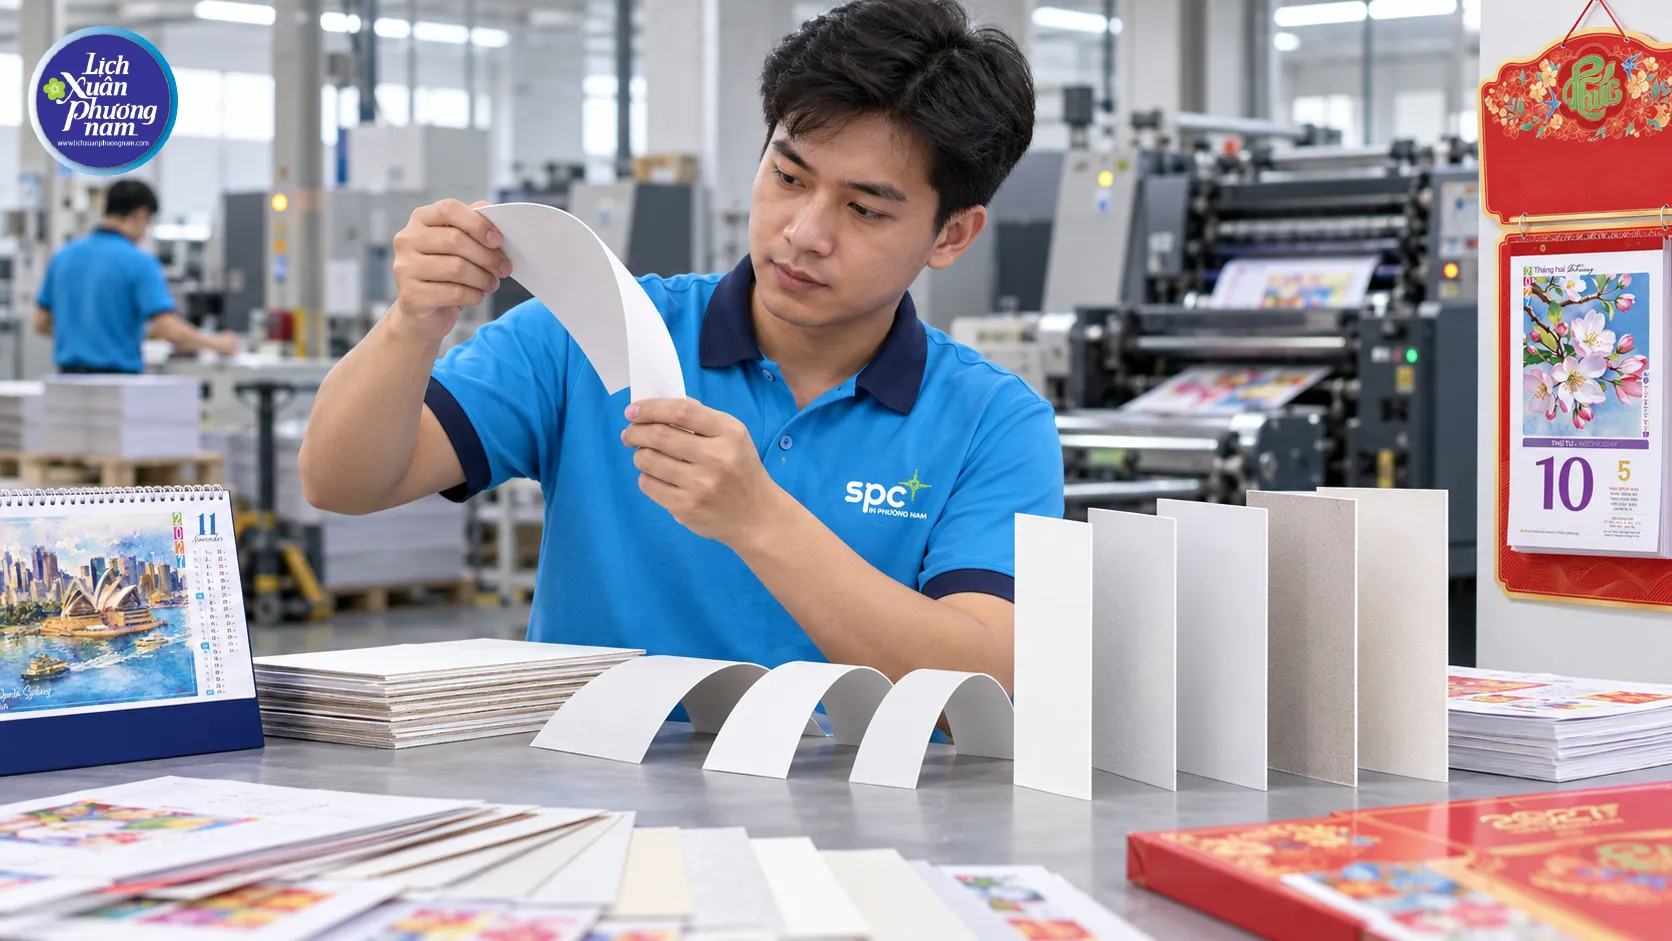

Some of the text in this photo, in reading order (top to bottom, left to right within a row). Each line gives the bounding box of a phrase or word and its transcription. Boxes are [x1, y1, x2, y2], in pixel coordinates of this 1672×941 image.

[844, 480, 907, 513] spc
[1536, 456, 1631, 512] 10 5
[198, 512, 217, 536] 11
